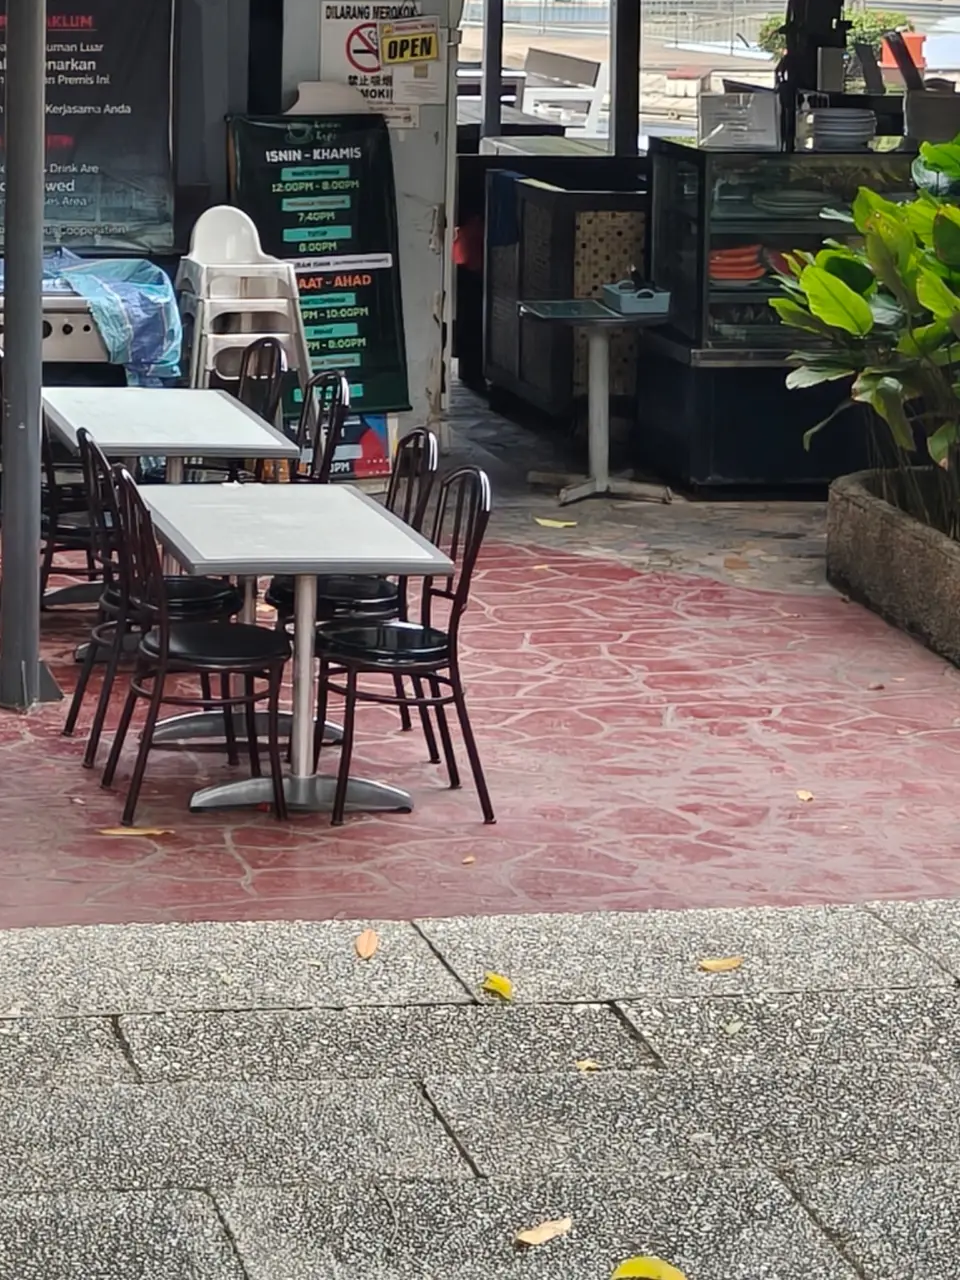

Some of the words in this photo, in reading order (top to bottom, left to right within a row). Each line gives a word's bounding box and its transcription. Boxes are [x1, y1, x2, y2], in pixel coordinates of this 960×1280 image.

[325, 6, 370, 19] DILARANG
[47, 15, 93, 27] KLUM
[46, 43, 78, 52] uman
[80, 42, 104, 52] Luar
[388, 36, 433, 59] OPEN
[45, 58, 96, 70] narkan
[58, 75, 93, 85] Premis
[45, 104, 101, 116] Kerjasama
[103, 104, 131, 114] Anda
[266, 150, 302, 162] ISNIN
[313, 147, 361, 160] KHAMIS
[49, 163, 77, 173] Drink
[80, 164, 99, 173] Are
[299, 277, 323, 289] AAT
[333, 275, 372, 287] AHAD
